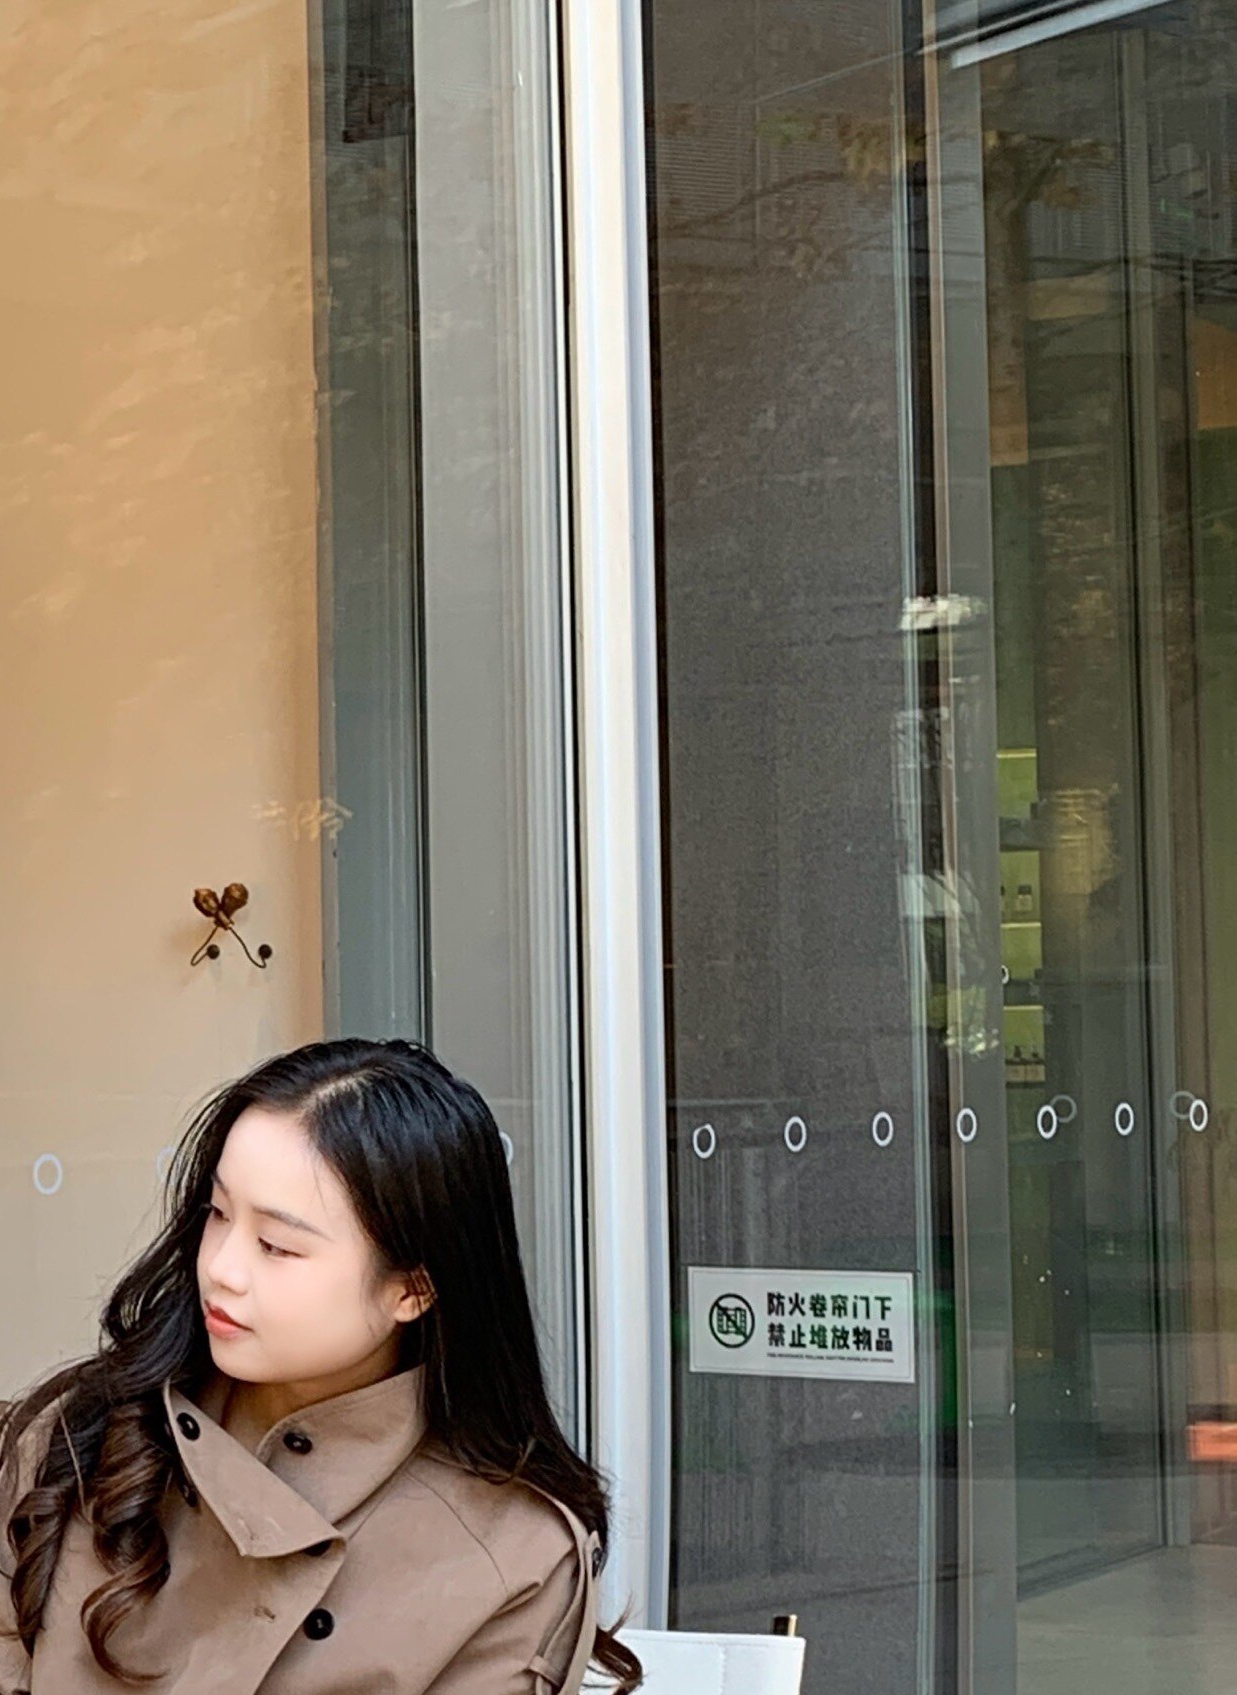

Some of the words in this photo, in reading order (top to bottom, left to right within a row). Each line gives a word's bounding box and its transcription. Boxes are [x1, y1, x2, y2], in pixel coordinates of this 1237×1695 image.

[766, 1292, 892, 1320] 防火卷帘门下
[767, 1322, 893, 1352] 禁止堆放物品
